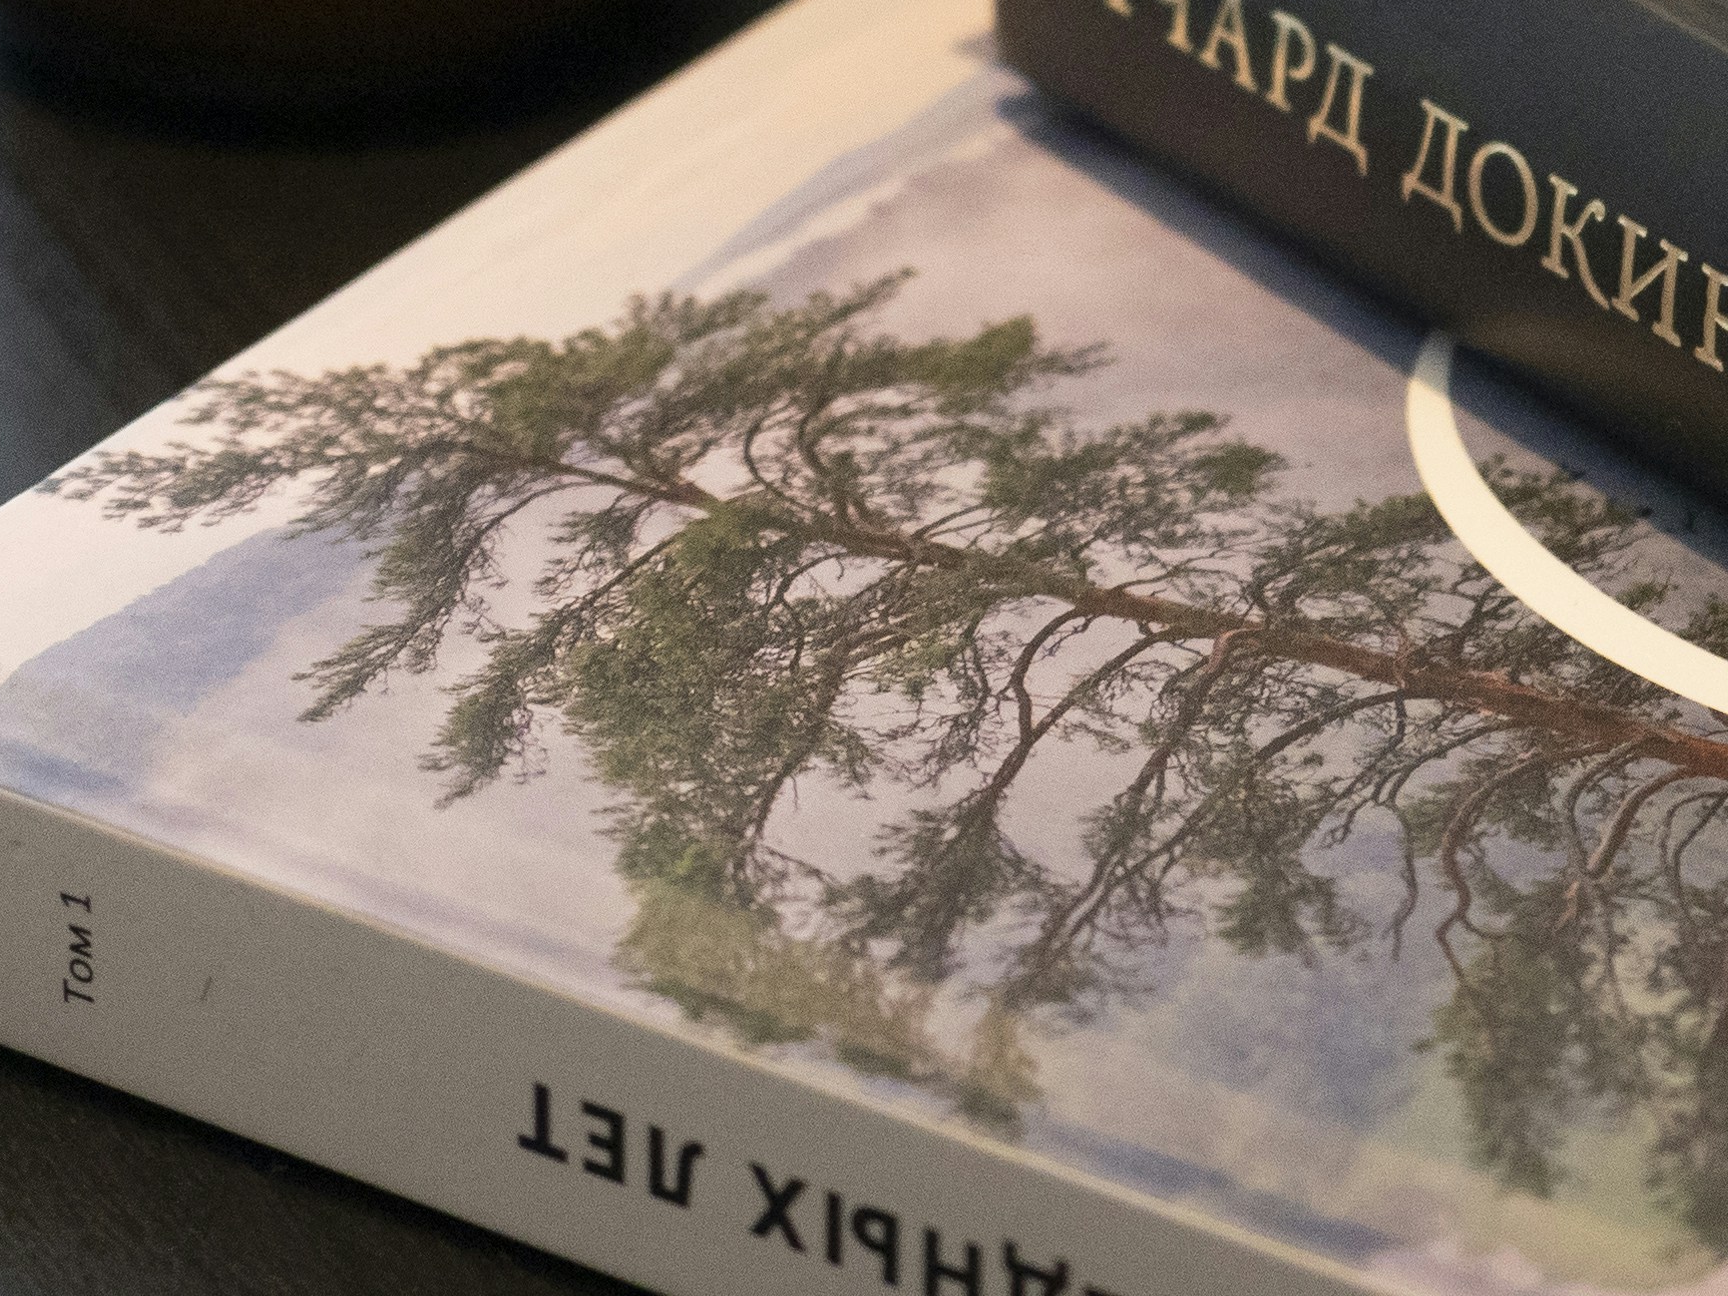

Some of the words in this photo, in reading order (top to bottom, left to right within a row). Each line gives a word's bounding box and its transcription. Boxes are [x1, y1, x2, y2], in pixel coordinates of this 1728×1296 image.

[60, 890, 92, 913] 1
[62, 924, 96, 1005] Том
[517, 1082, 705, 1209] ЛЕТ
[749, 1160, 1110, 1296] ДНЫХ
